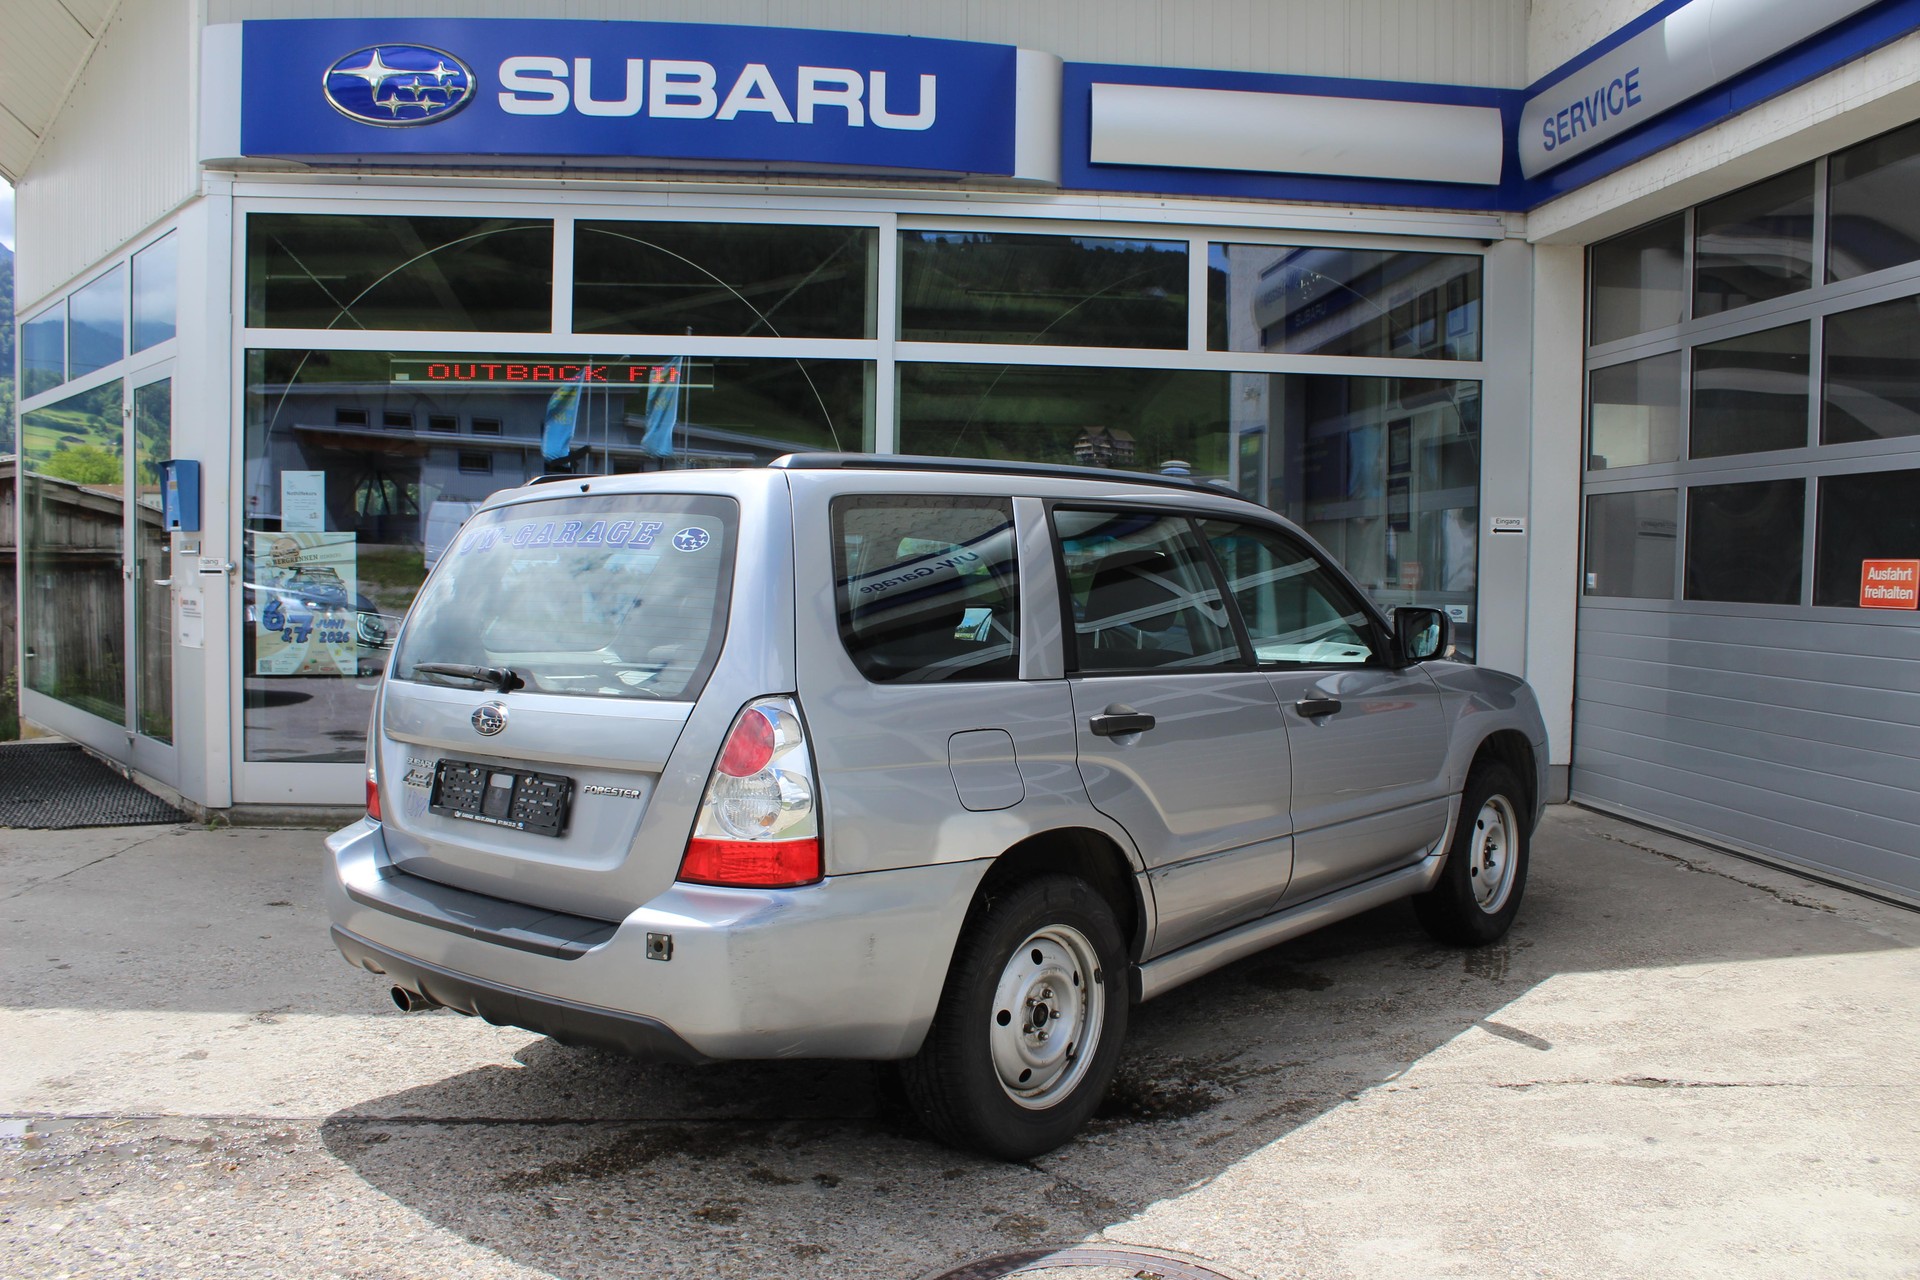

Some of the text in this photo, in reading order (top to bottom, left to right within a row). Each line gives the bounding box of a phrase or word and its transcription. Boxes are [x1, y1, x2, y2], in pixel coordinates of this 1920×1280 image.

[498, 56, 937, 131] SUBARU
[1542, 66, 1642, 151] SERVICE
[427, 363, 607, 381] OUTBACK
[1495, 517, 1521, 525] Eingang
[460, 520, 664, 555] UW-GARAGE
[1867, 566, 1913, 581] Ausfahrt
[1864, 585, 1914, 600] freihalten
[263, 599, 286, 631] 6
[316, 618, 345, 630] JUNI
[319, 631, 350, 643] 2026
[583, 785, 641, 799] FORESTER
